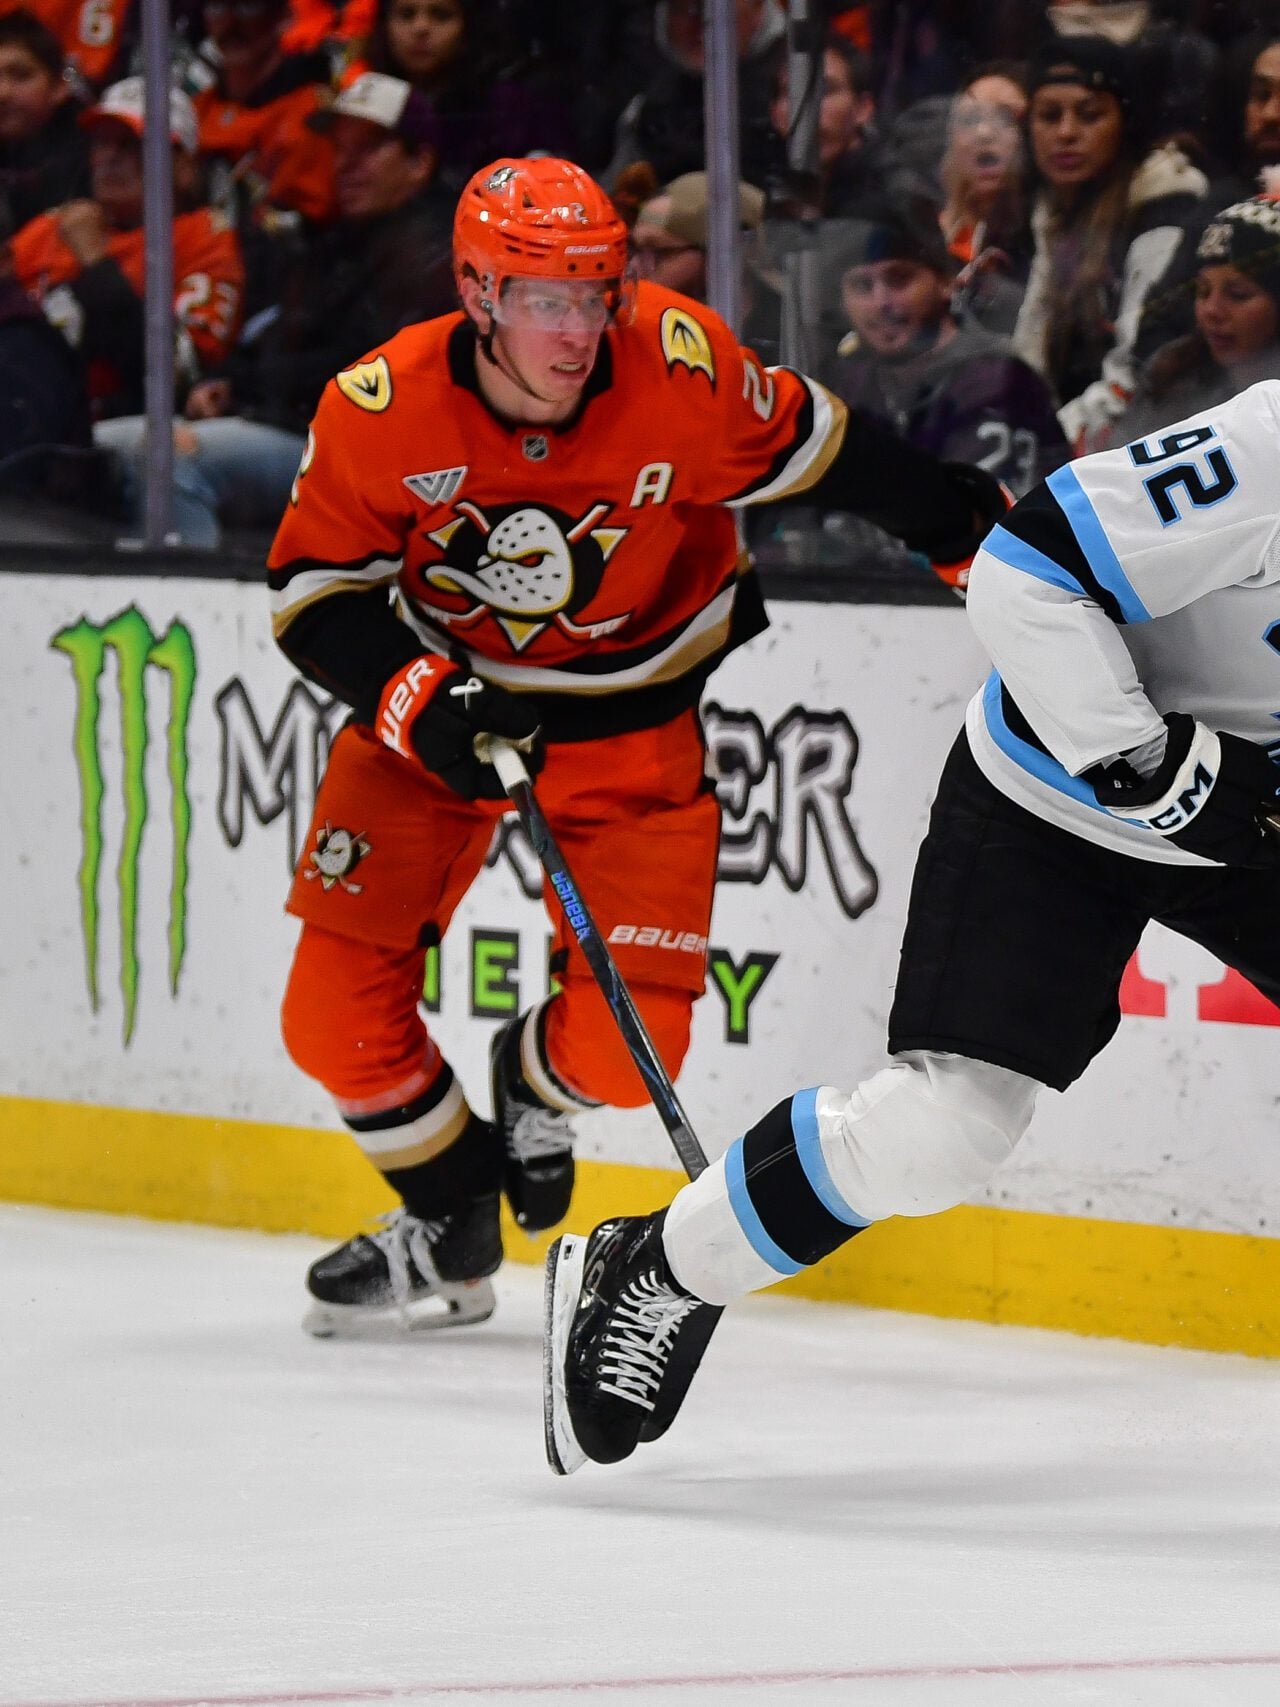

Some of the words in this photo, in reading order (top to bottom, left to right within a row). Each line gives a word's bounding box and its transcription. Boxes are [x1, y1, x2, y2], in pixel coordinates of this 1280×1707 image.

[742, 358, 774, 421] 2
[629, 462, 674, 508] A
[1127, 424, 1239, 529] 92
[1148, 760, 1215, 830] CM
